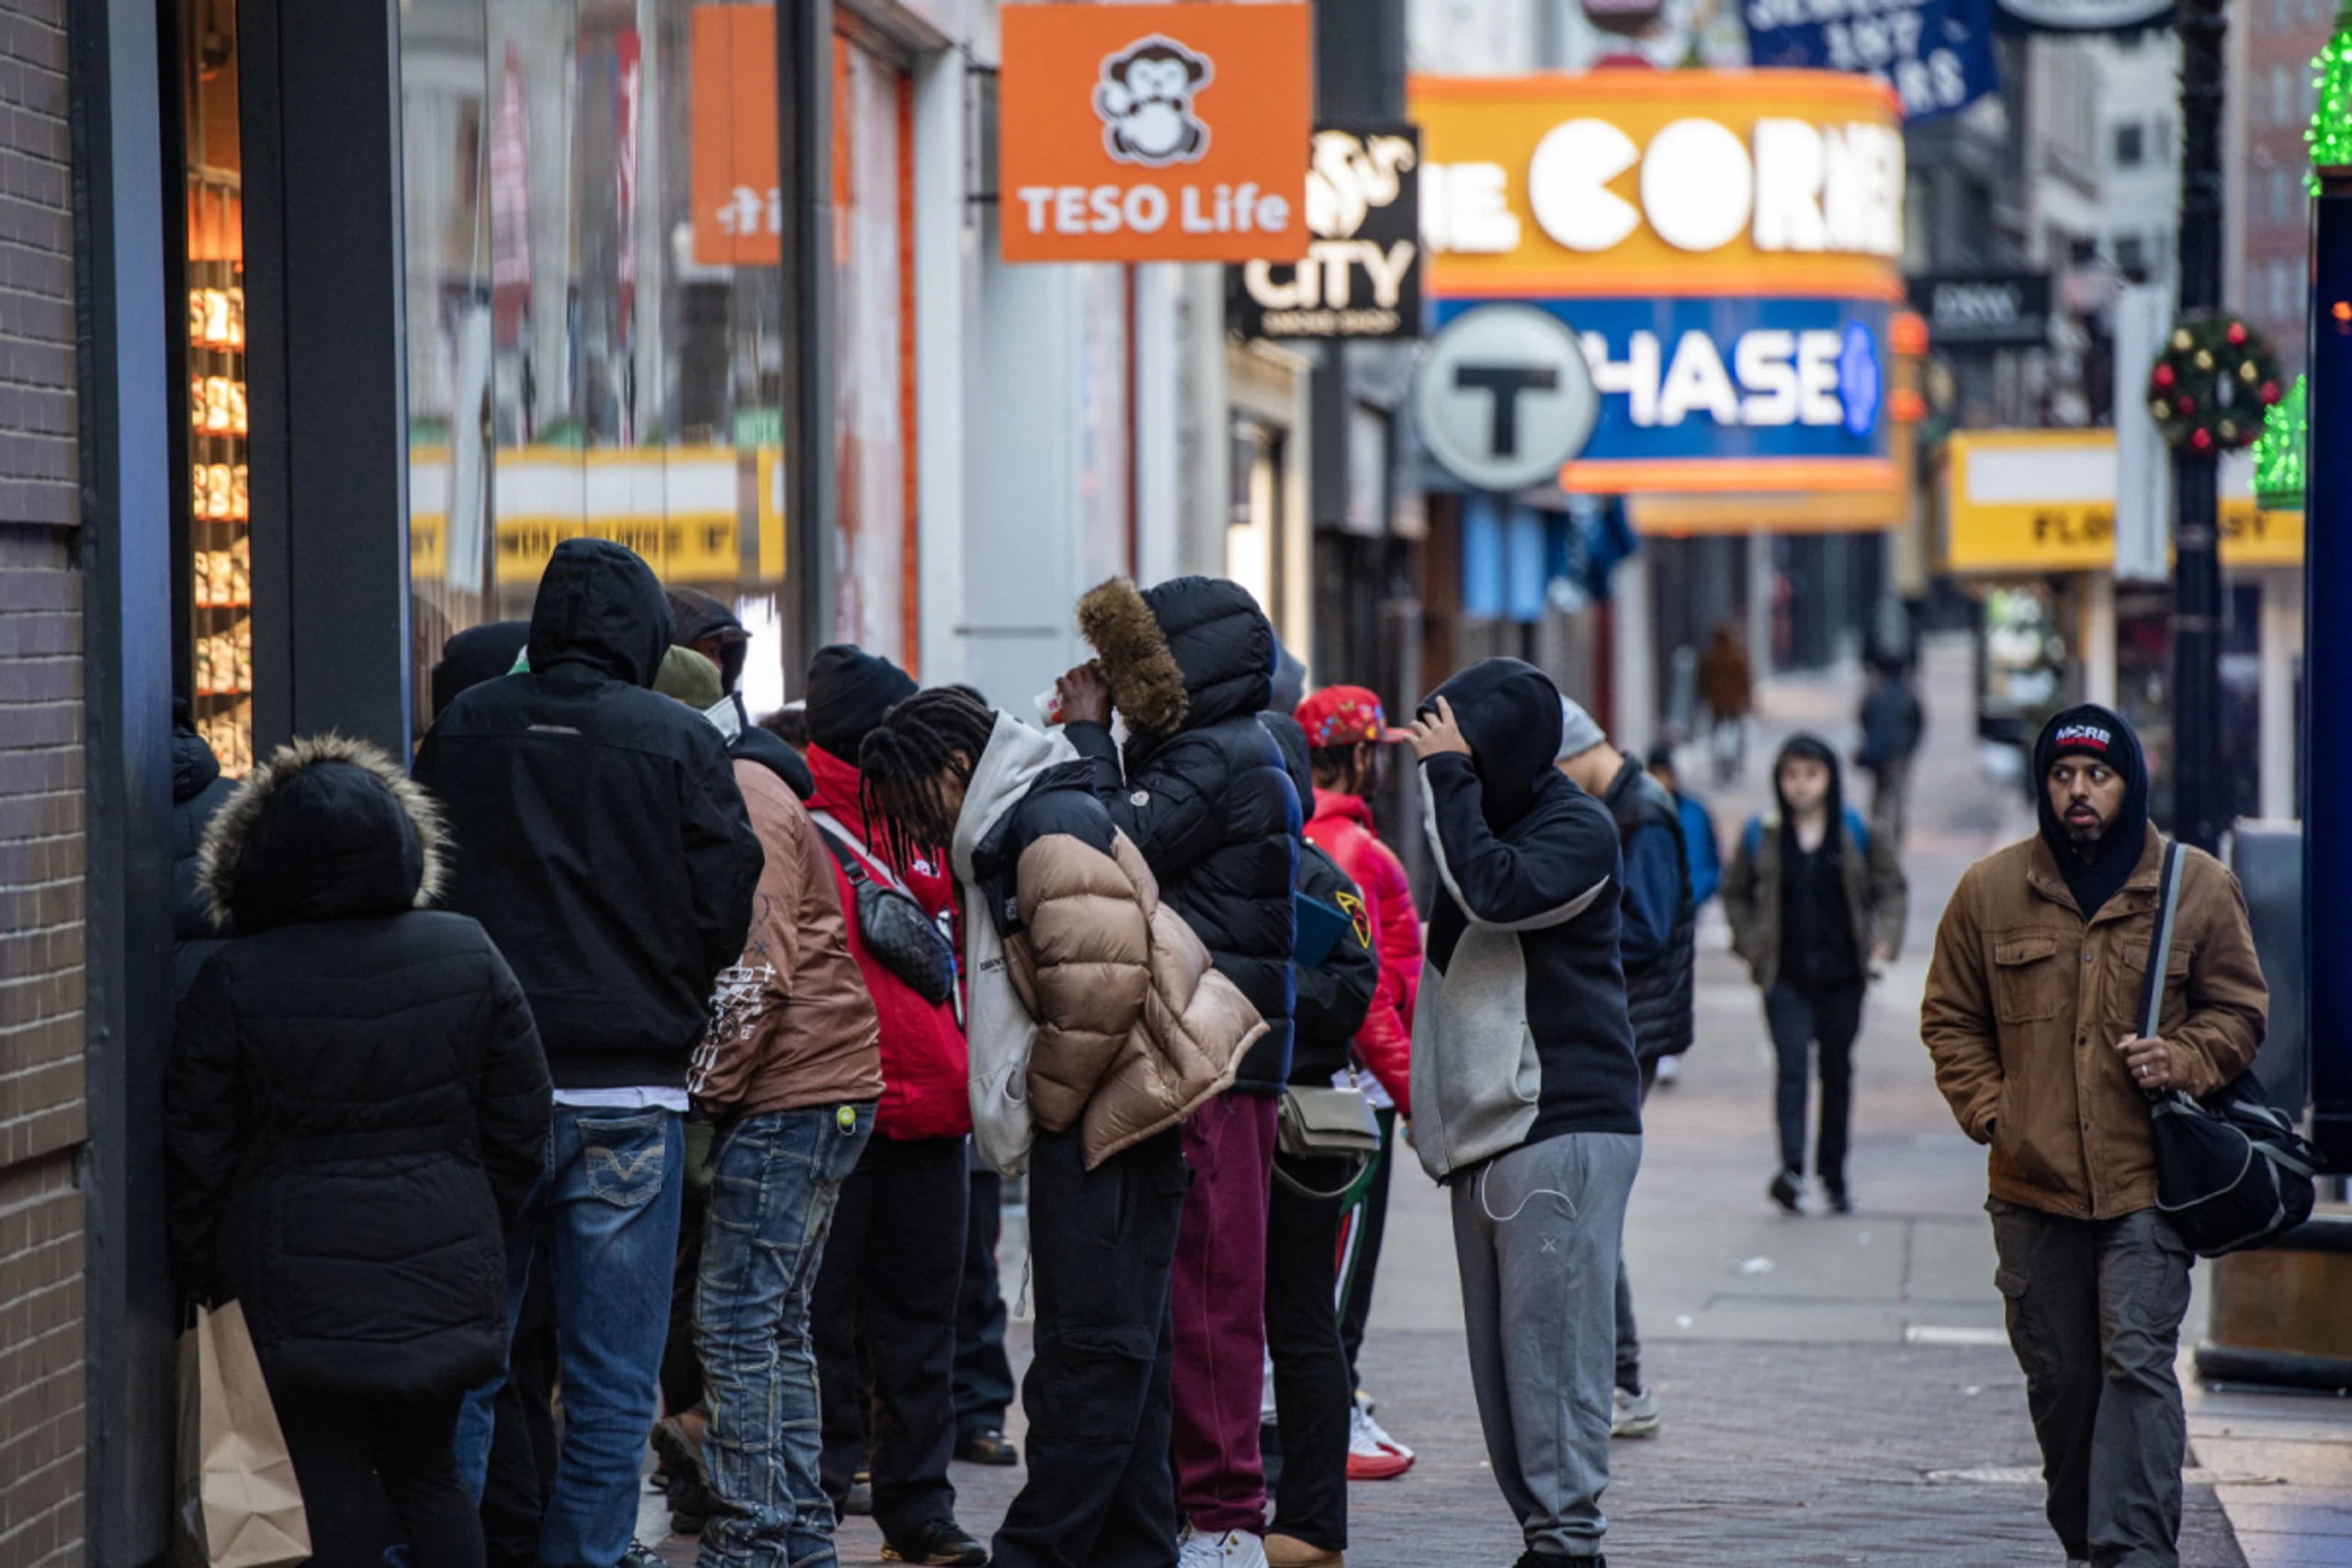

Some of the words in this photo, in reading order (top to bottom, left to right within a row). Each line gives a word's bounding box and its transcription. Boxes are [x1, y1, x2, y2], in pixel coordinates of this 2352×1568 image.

[1017, 185, 1169, 234] TESO
[1182, 183, 1290, 233] Life
[1244, 239, 1416, 310] CITY
[1453, 364, 1558, 457] T
[1580, 329, 1843, 427] HASE
